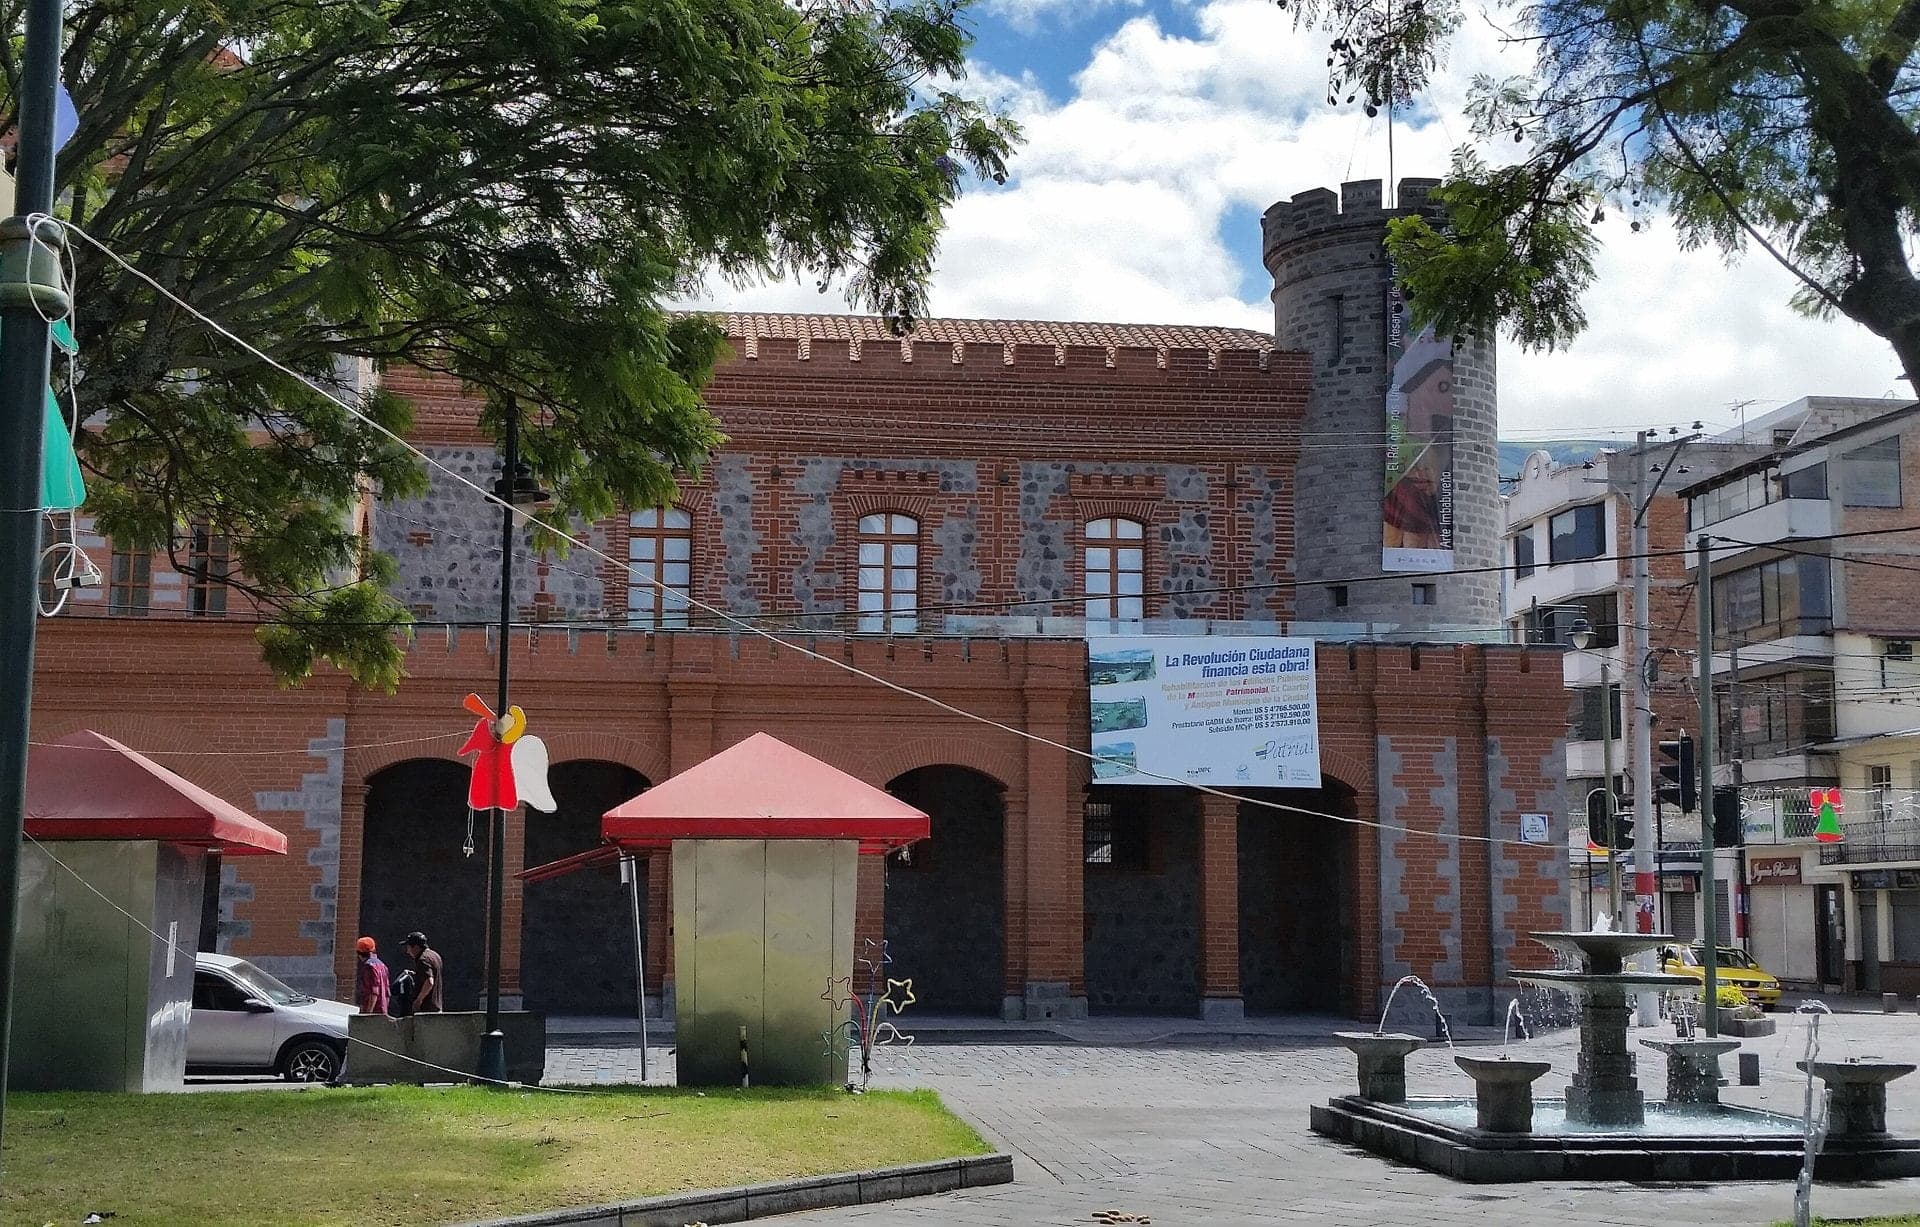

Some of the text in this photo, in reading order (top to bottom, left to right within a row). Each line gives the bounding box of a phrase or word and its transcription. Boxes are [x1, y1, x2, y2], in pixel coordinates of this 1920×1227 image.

[1388, 299, 1400, 348] Artesans
[1387, 462, 1399, 471] El
[1439, 471, 1452, 549] Arte Imbabureño
[1166, 647, 1310, 667] La Revolución Ciudadana
[1202, 659, 1309, 678] financia esta obra!
